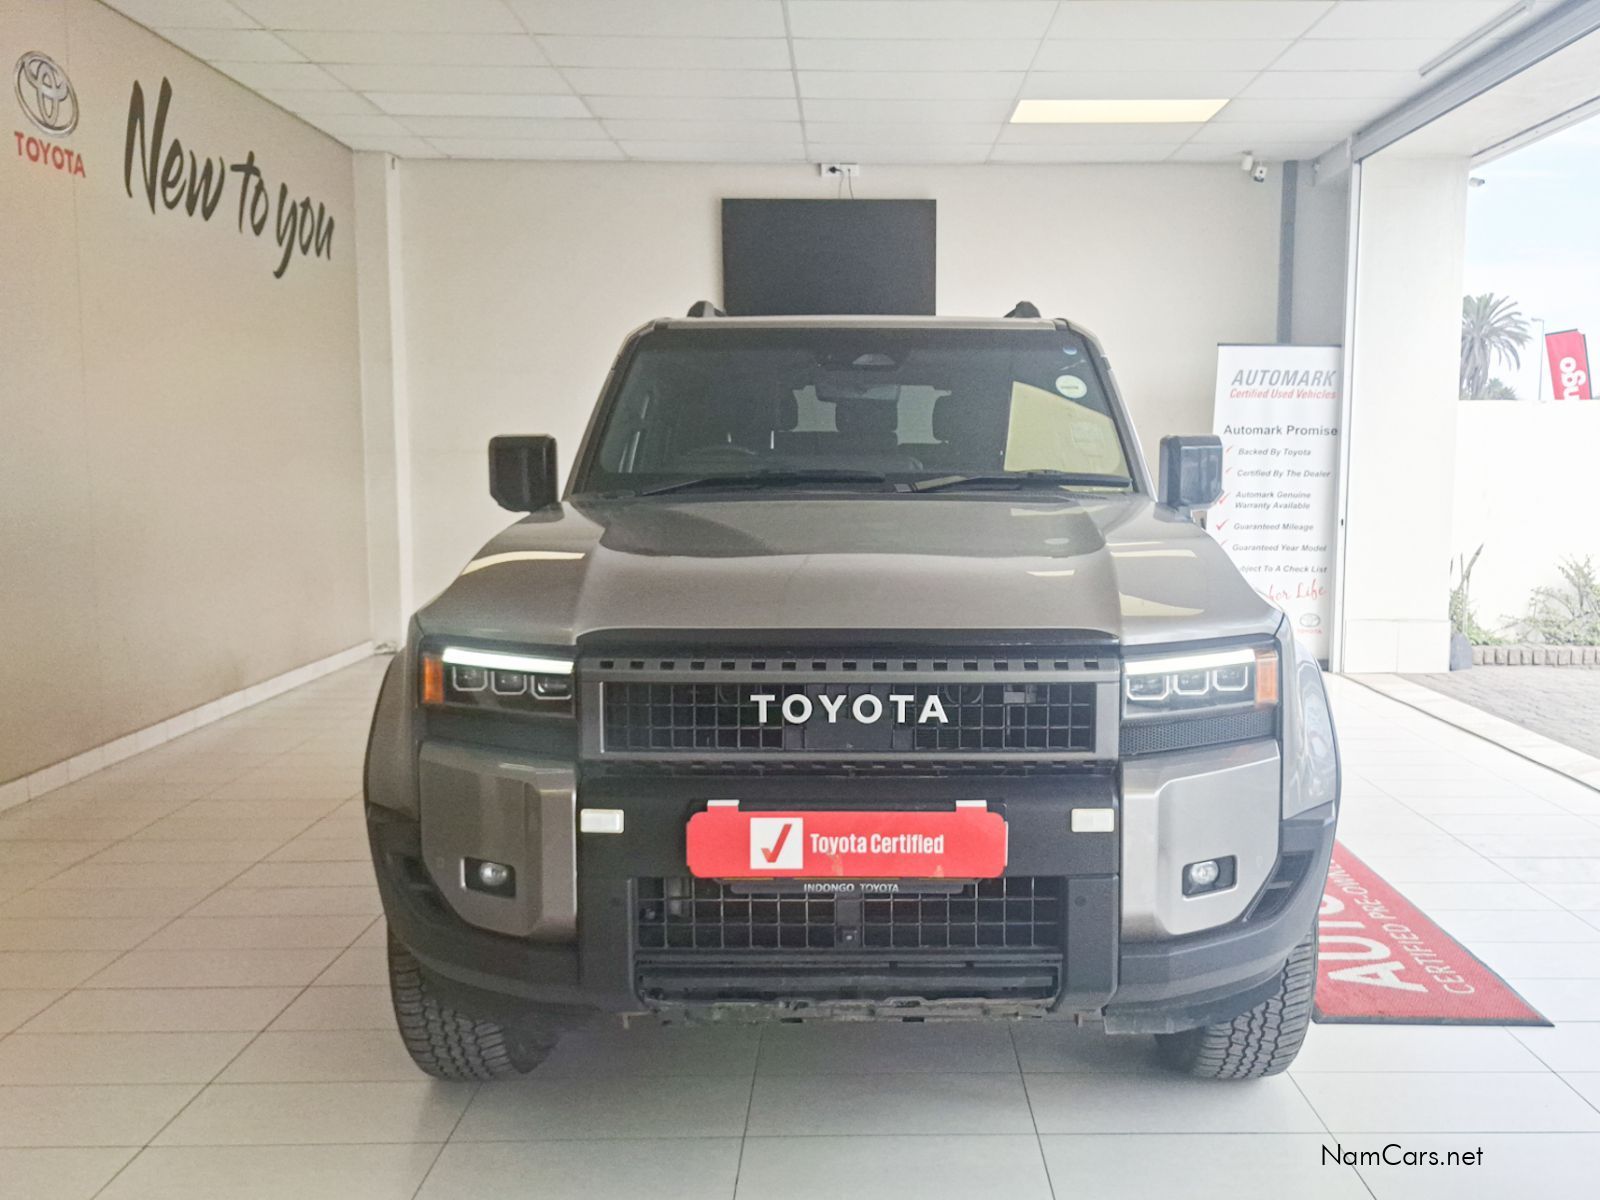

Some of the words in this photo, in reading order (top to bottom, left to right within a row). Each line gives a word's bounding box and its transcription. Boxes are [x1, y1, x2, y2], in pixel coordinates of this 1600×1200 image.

[14, 131, 86, 178] TOYOTA
[124, 76, 226, 222] New
[230, 150, 269, 236] to
[273, 182, 335, 279] you
[1231, 369, 1337, 387] AUTOMARK
[1230, 388, 1269, 399] Certified
[1270, 389, 1294, 399] Used
[1296, 389, 1338, 400] Vehicles
[1223, 425, 1282, 435] Automark
[1286, 425, 1338, 436] Promise
[1238, 448, 1268, 456] Backed
[1270, 448, 1281, 457] By
[1283, 448, 1311, 457] Toyota
[1237, 469, 1271, 478] Certified
[1272, 469, 1283, 478] By
[1286, 469, 1301, 477] The
[1303, 469, 1331, 478] Dealer
[1276, 491, 1311, 499] Genuine
[1235, 502, 1270, 510] Warranty
[1272, 502, 1311, 510] Available
[1233, 523, 1280, 531] Guaranteed
[1282, 523, 1314, 532] Mileage
[1232, 544, 1279, 552] Guaranteed
[1281, 544, 1299, 552] Year
[1301, 544, 1328, 552] Model
[1264, 565, 1273, 573] To
[1275, 565, 1281, 573] A
[1283, 565, 1308, 573] Check
[1311, 566, 1328, 574] List
[750, 694, 949, 724] TOYOTA
[810, 833, 867, 855] Toyota
[870, 834, 945, 855] Certified
[803, 882, 855, 893] INDONGO
[860, 883, 899, 893] TOYOTA
[1382, 922, 1475, 995] CERTIFIED
